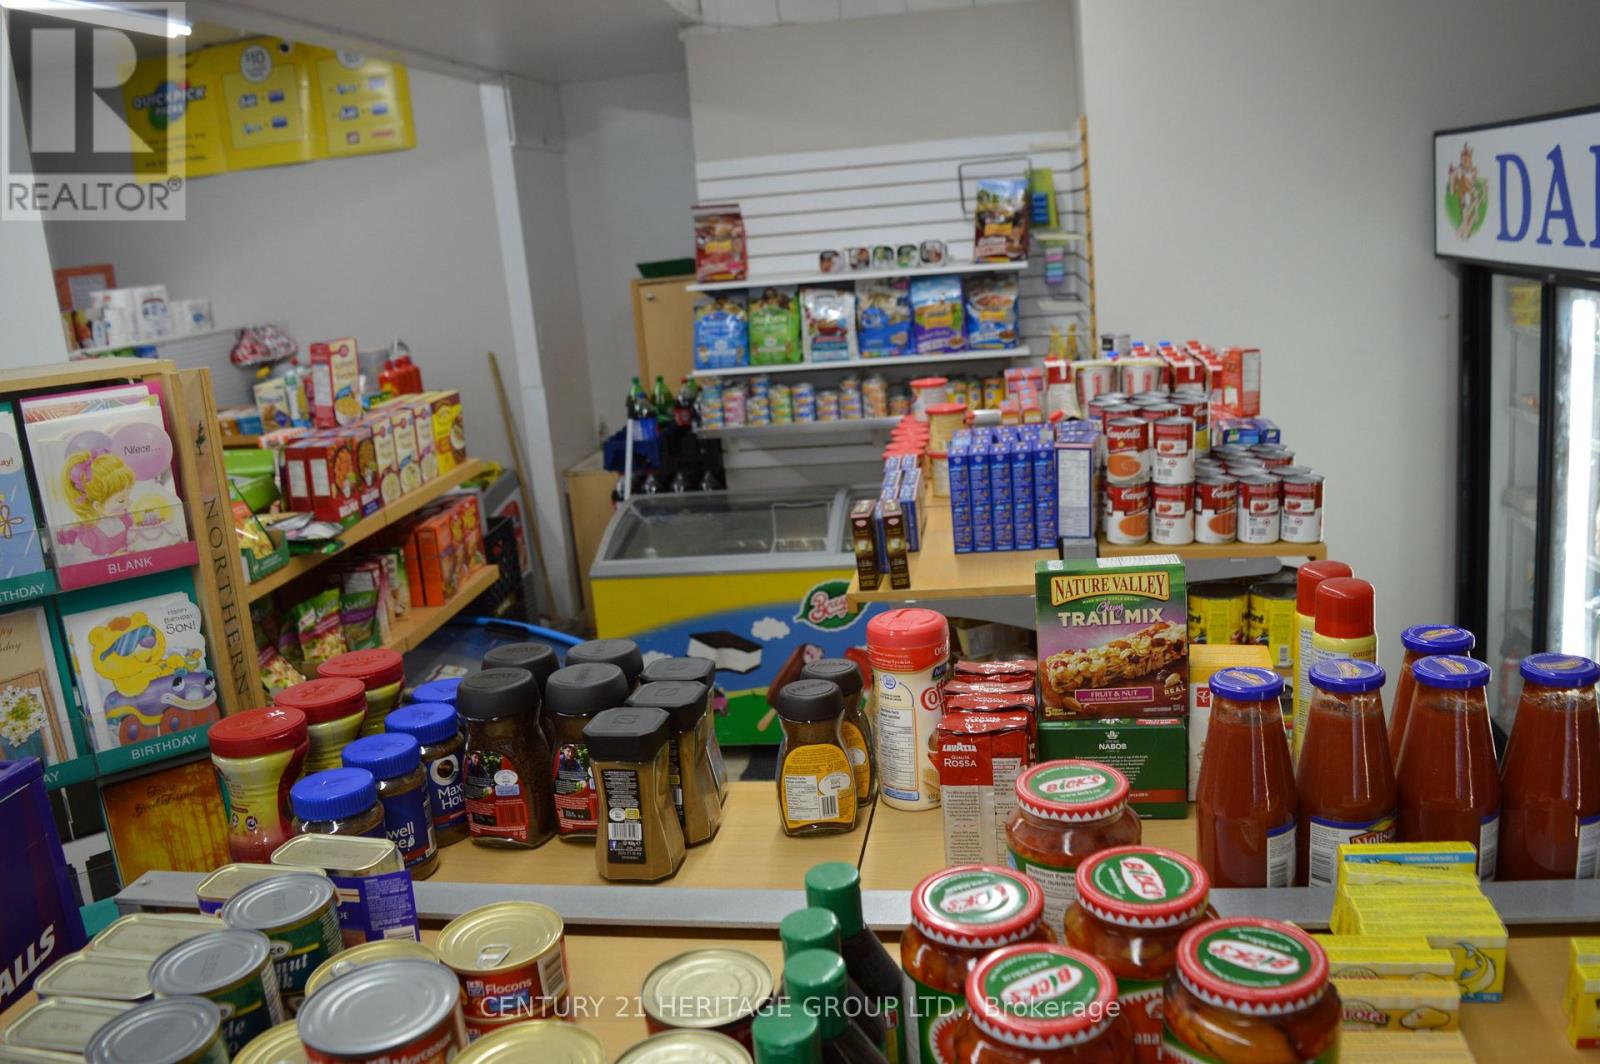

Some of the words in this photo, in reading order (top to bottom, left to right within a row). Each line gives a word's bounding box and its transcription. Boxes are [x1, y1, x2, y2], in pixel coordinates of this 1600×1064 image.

[108, 556, 153, 575] BLANK
[203, 497, 249, 696] NORTHERN
[1054, 575, 1110, 602] NATURE
[1111, 574, 1167, 598] VALLEY
[1058, 610, 1121, 628] TRAIL
[1124, 608, 1164, 626] MIX
[1090, 690, 1113, 698] FRUIT
[1121, 689, 1138, 697] NUT
[131, 732, 198, 760] BIRTHDAY
[942, 742, 977, 752] LAVAZZA
[1098, 743, 1127, 751] NABOB
[485, 978, 532, 994] Flocons
